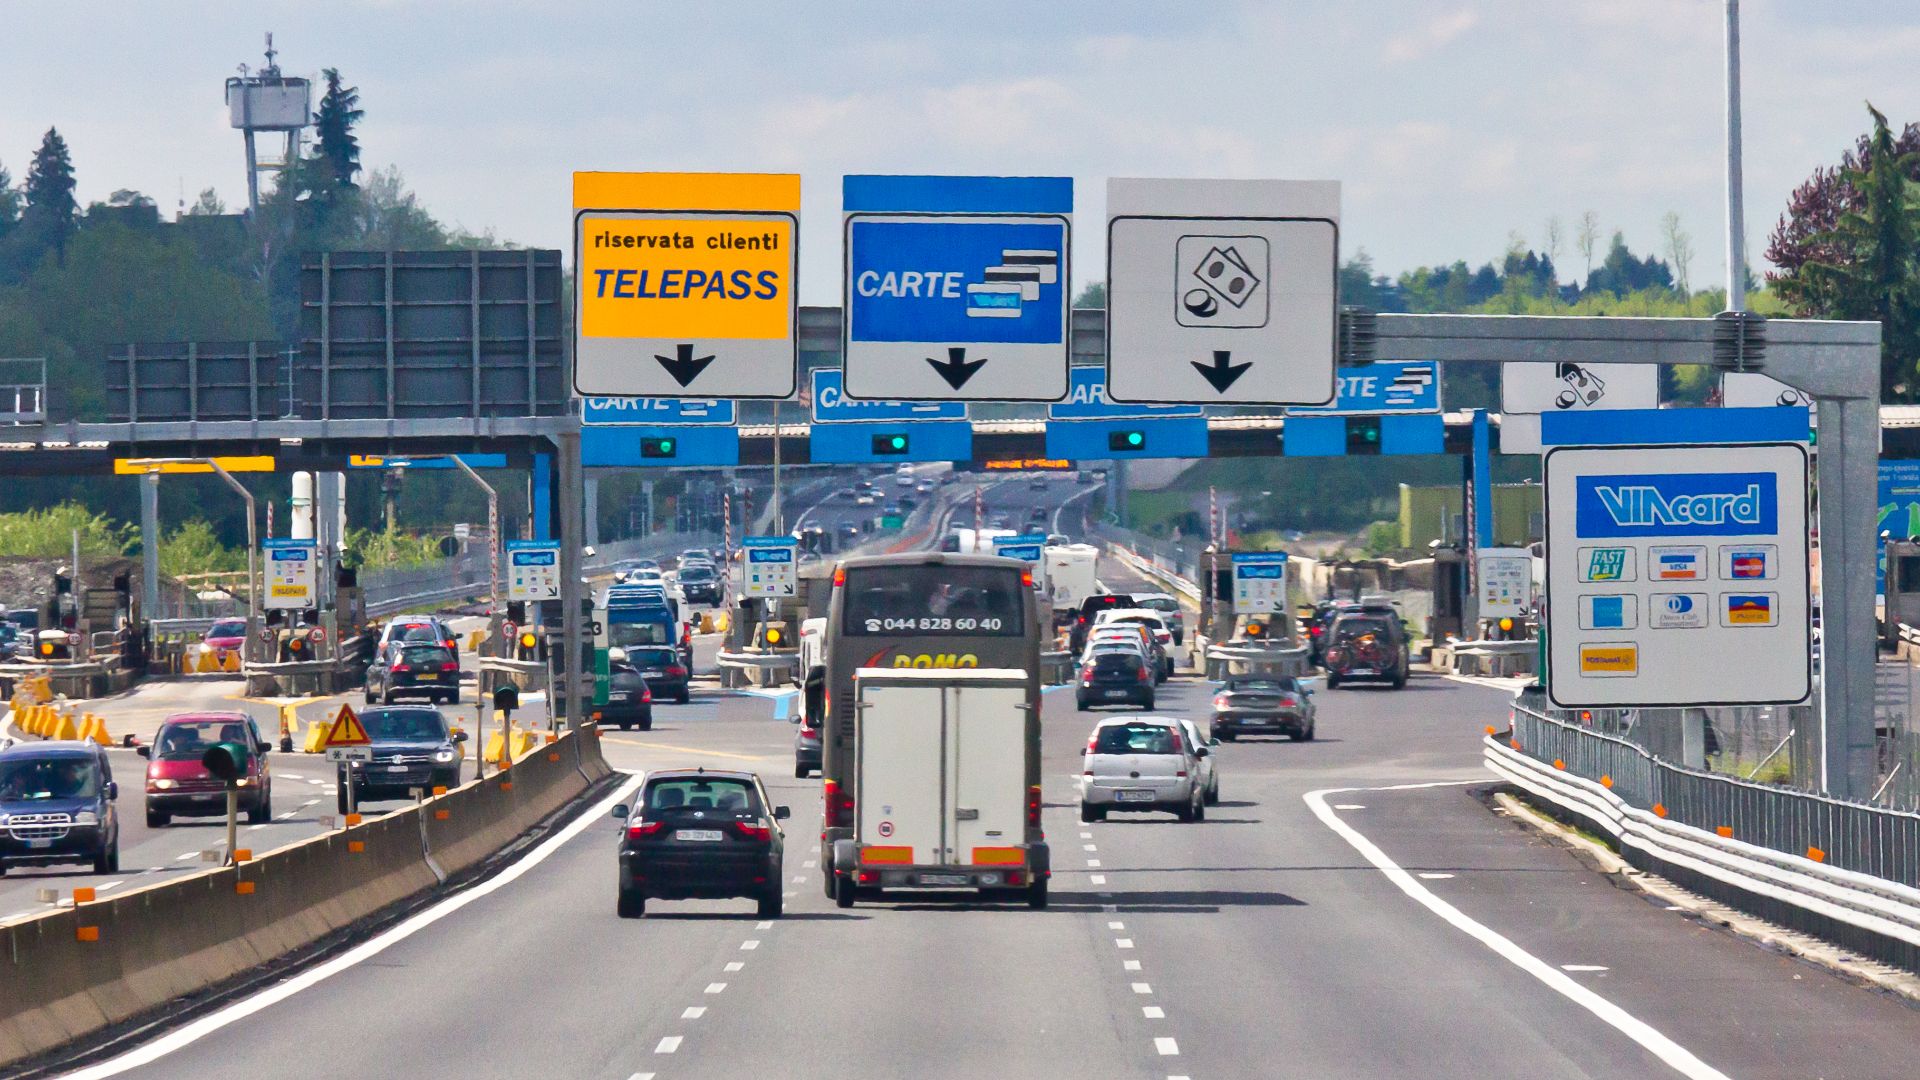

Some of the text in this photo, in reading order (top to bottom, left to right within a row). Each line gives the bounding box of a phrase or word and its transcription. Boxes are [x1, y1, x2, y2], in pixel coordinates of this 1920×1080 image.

[595, 231, 778, 250] riservata clienti
[594, 269, 779, 300] TELEPASS
[857, 270, 964, 298] CARTE
[1594, 551, 1623, 564] FAST
[1591, 562, 1620, 577] pay
[884, 618, 1002, 630] 044 828 60 40
